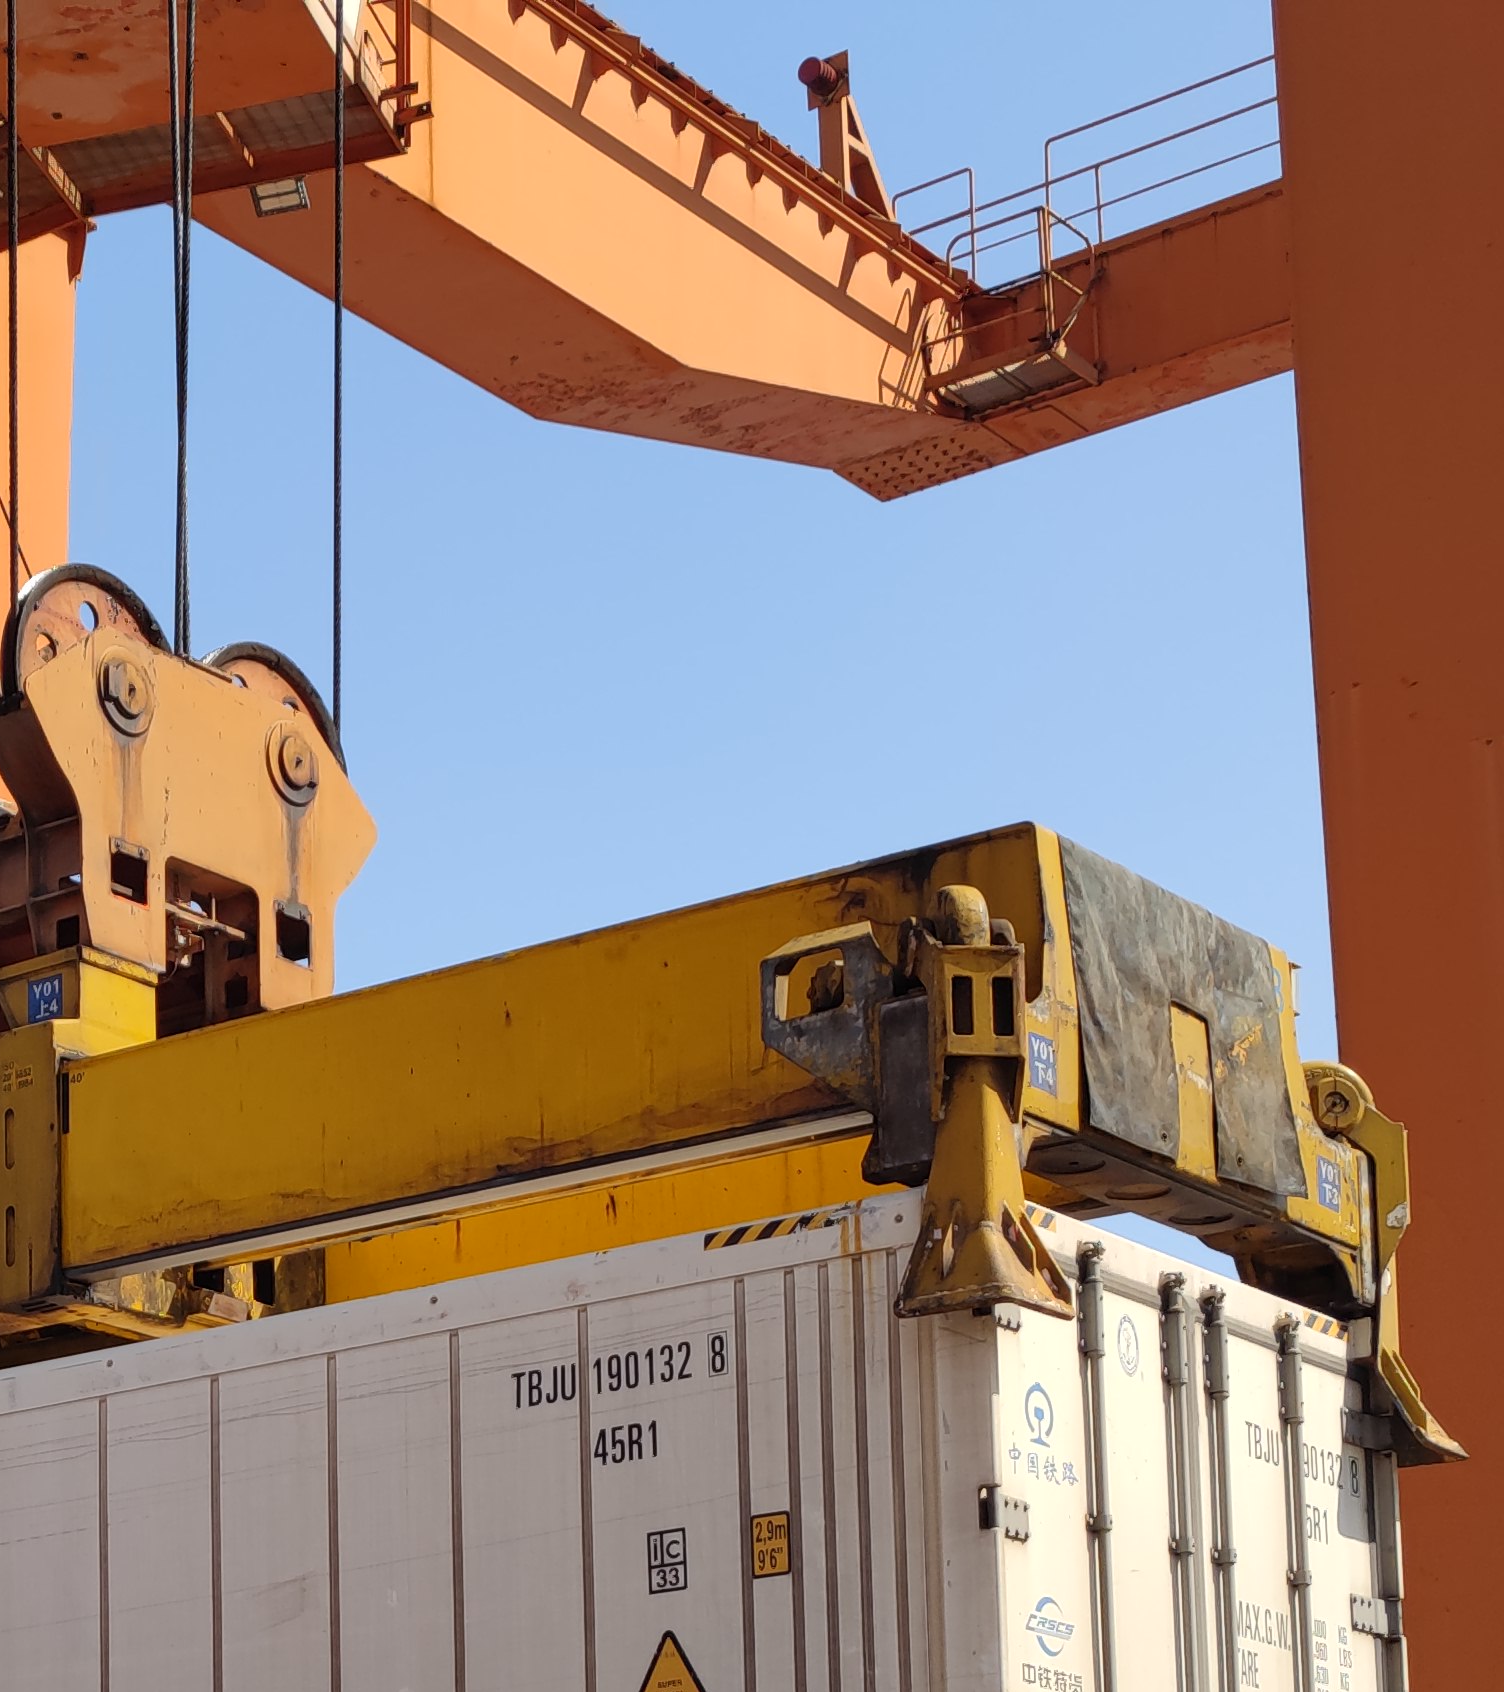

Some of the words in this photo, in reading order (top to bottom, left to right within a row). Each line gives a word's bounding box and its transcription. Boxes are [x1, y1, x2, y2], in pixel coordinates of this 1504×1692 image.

[33, 978, 60, 999] Y01
[70, 1072, 85, 1084] 40'
[511, 1362, 577, 1410] TBJU
[592, 1341, 693, 1395] 190132
[710, 1335, 726, 1374] 8
[593, 1419, 660, 1466] 45R1
[1245, 1420, 1280, 1466] TBJU
[1303, 1442, 1344, 1490] 90132
[1008, 1442, 1079, 1486] 中国铁路
[754, 1519, 786, 1546] 2,9m
[1305, 1504, 1329, 1545] 5R1
[656, 1567, 680, 1588] 33
[1025, 1613, 1075, 1636] CRSCS
[657, 1679, 683, 1689] SUPER
